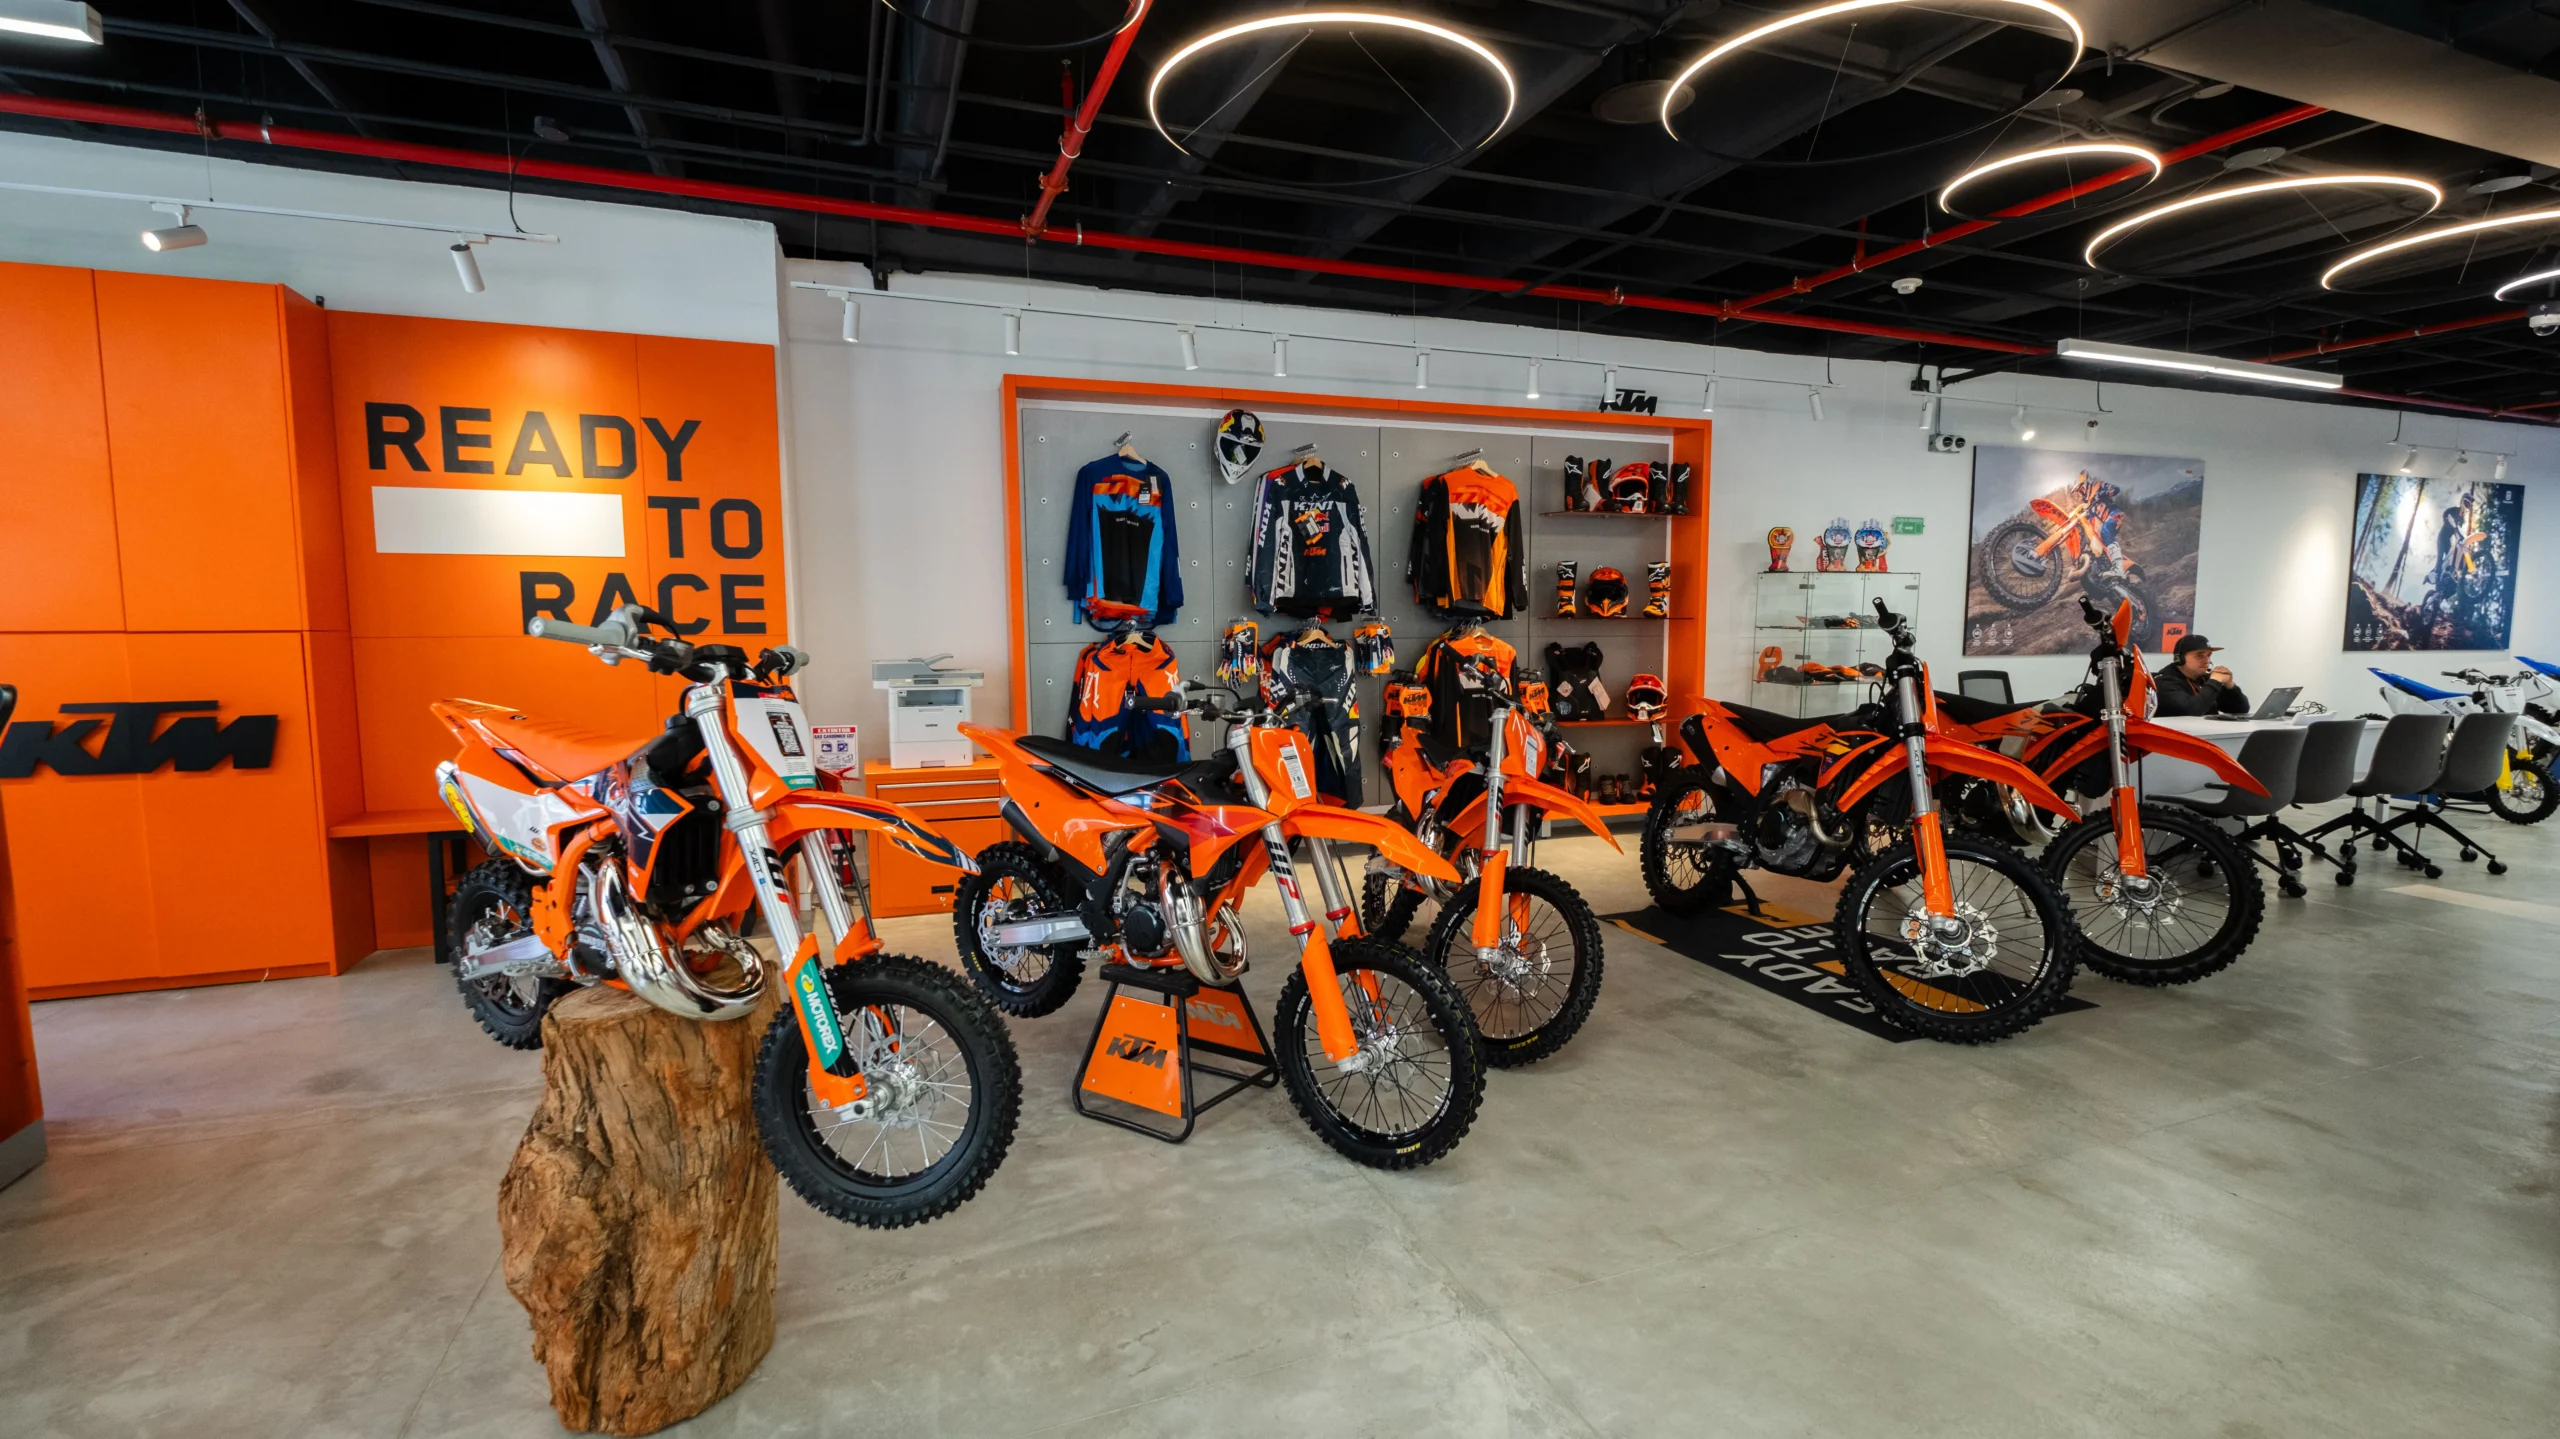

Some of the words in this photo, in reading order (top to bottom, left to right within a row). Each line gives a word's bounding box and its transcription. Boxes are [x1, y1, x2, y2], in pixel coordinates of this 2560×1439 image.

[1597, 388, 1658, 416] KTM
[364, 401, 701, 482] READY
[1294, 501, 1334, 511] KINI
[648, 495, 764, 560] TO
[1258, 501, 1272, 548] KINI
[1276, 530, 1290, 592] KINI
[1303, 547, 1327, 557] KTM
[520, 572, 767, 635] RACE
[2166, 627, 2184, 636] KTM
[1403, 689, 1427, 704] KTM
[1529, 687, 1545, 700] KTM
[3, 700, 278, 779] KTM
[750, 849, 764, 874] XACT
[1741, 931, 1828, 959] TO
[807, 992, 838, 1055] MOTOREX
[1106, 1033, 1167, 1070] KTM
[1508, 1035, 1538, 1050] MAXXIS
